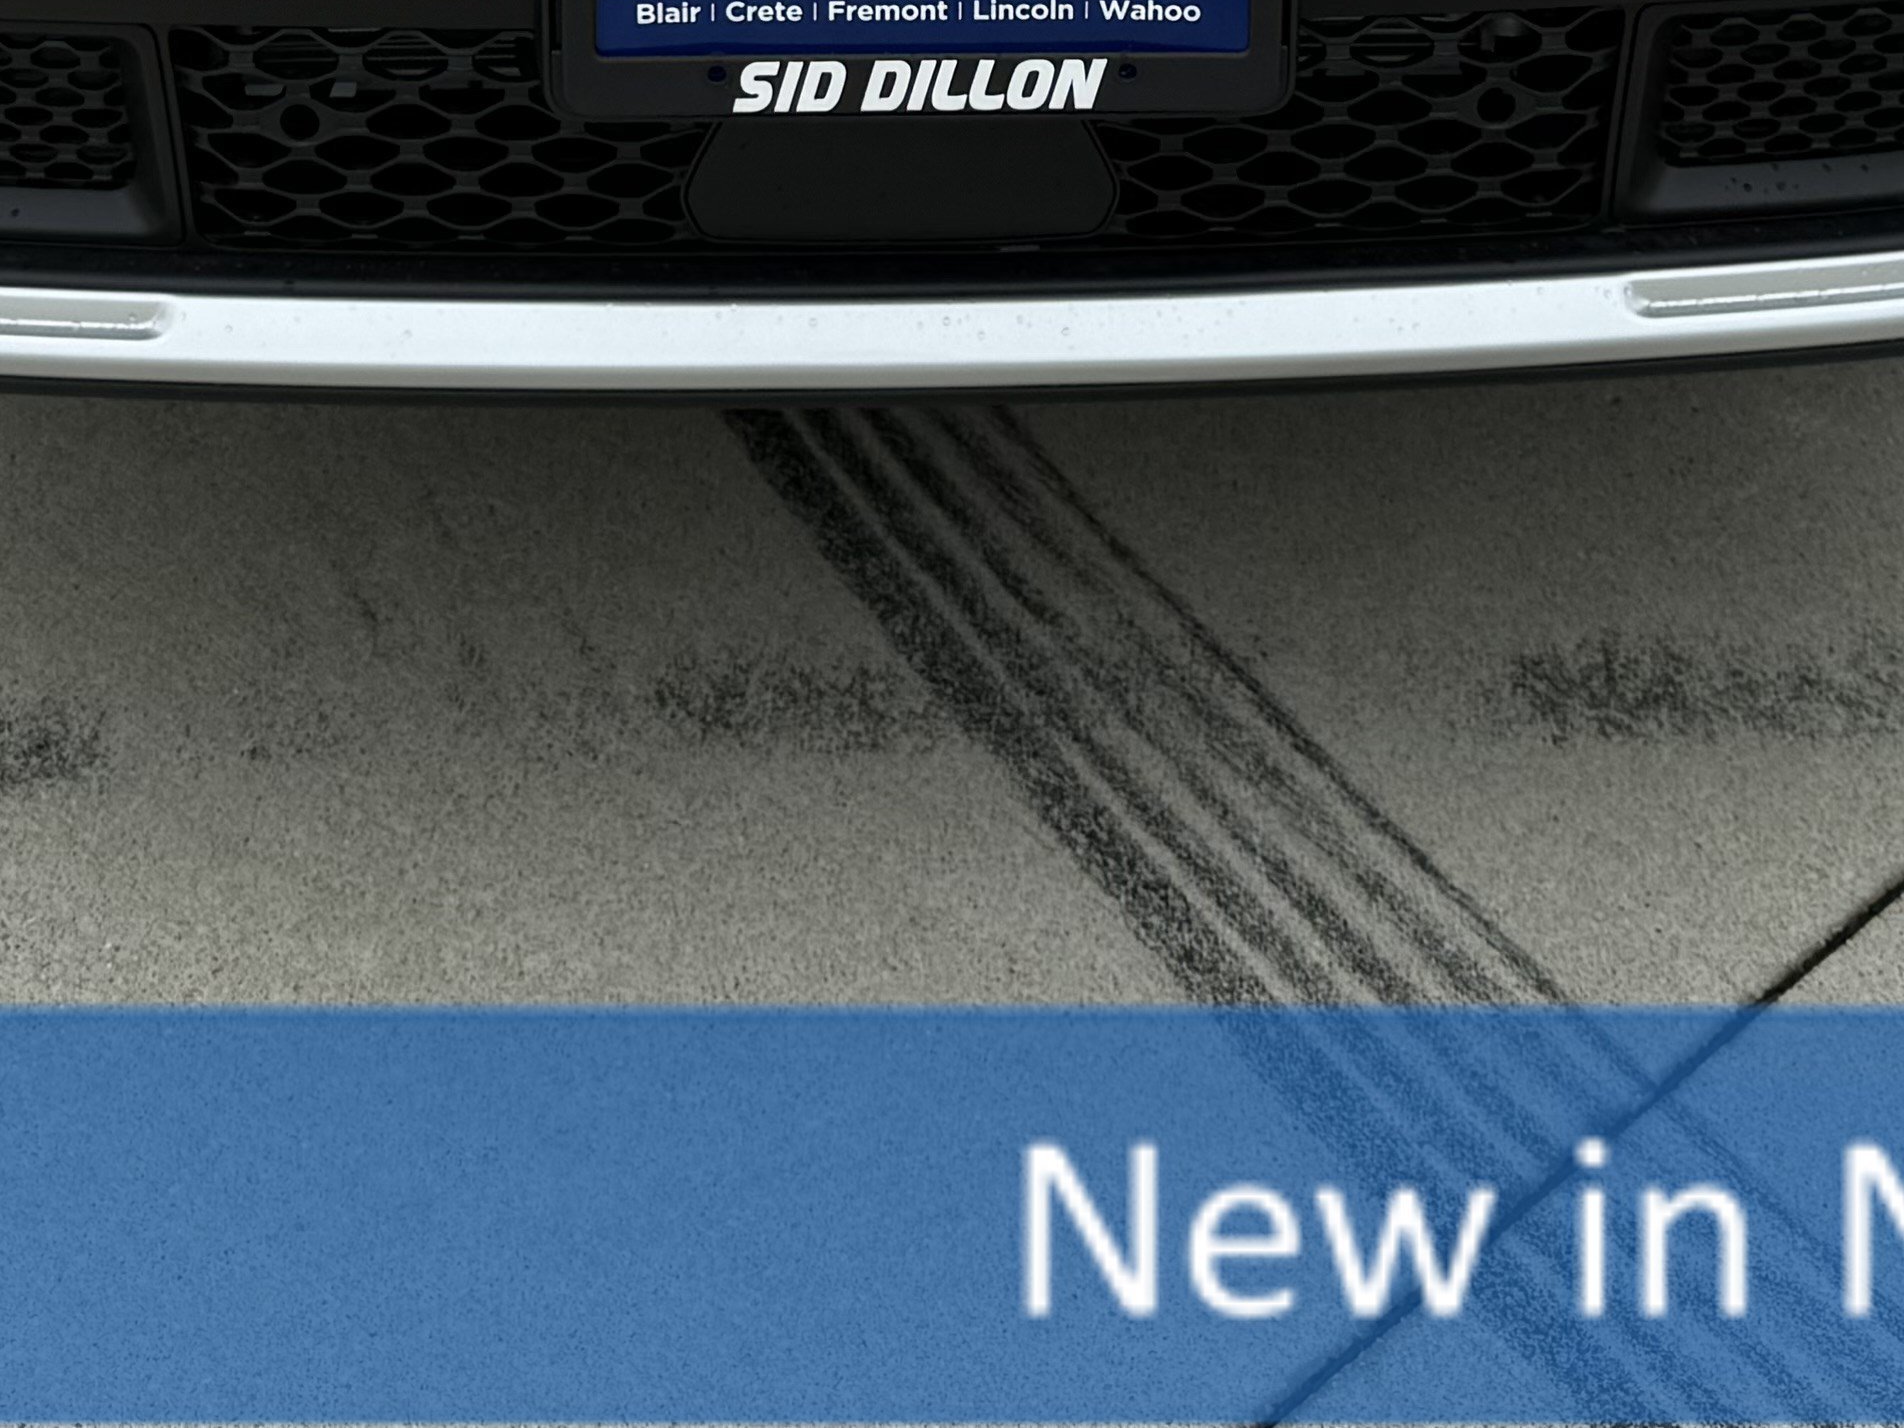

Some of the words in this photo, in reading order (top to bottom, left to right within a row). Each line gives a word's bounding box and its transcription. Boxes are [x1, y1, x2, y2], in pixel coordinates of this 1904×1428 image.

[636, 1, 702, 25] Blair
[725, 0, 804, 23] Crete
[828, 0, 949, 22] Fremont
[731, 60, 847, 113] SID
[860, 58, 1108, 112] DILLON
